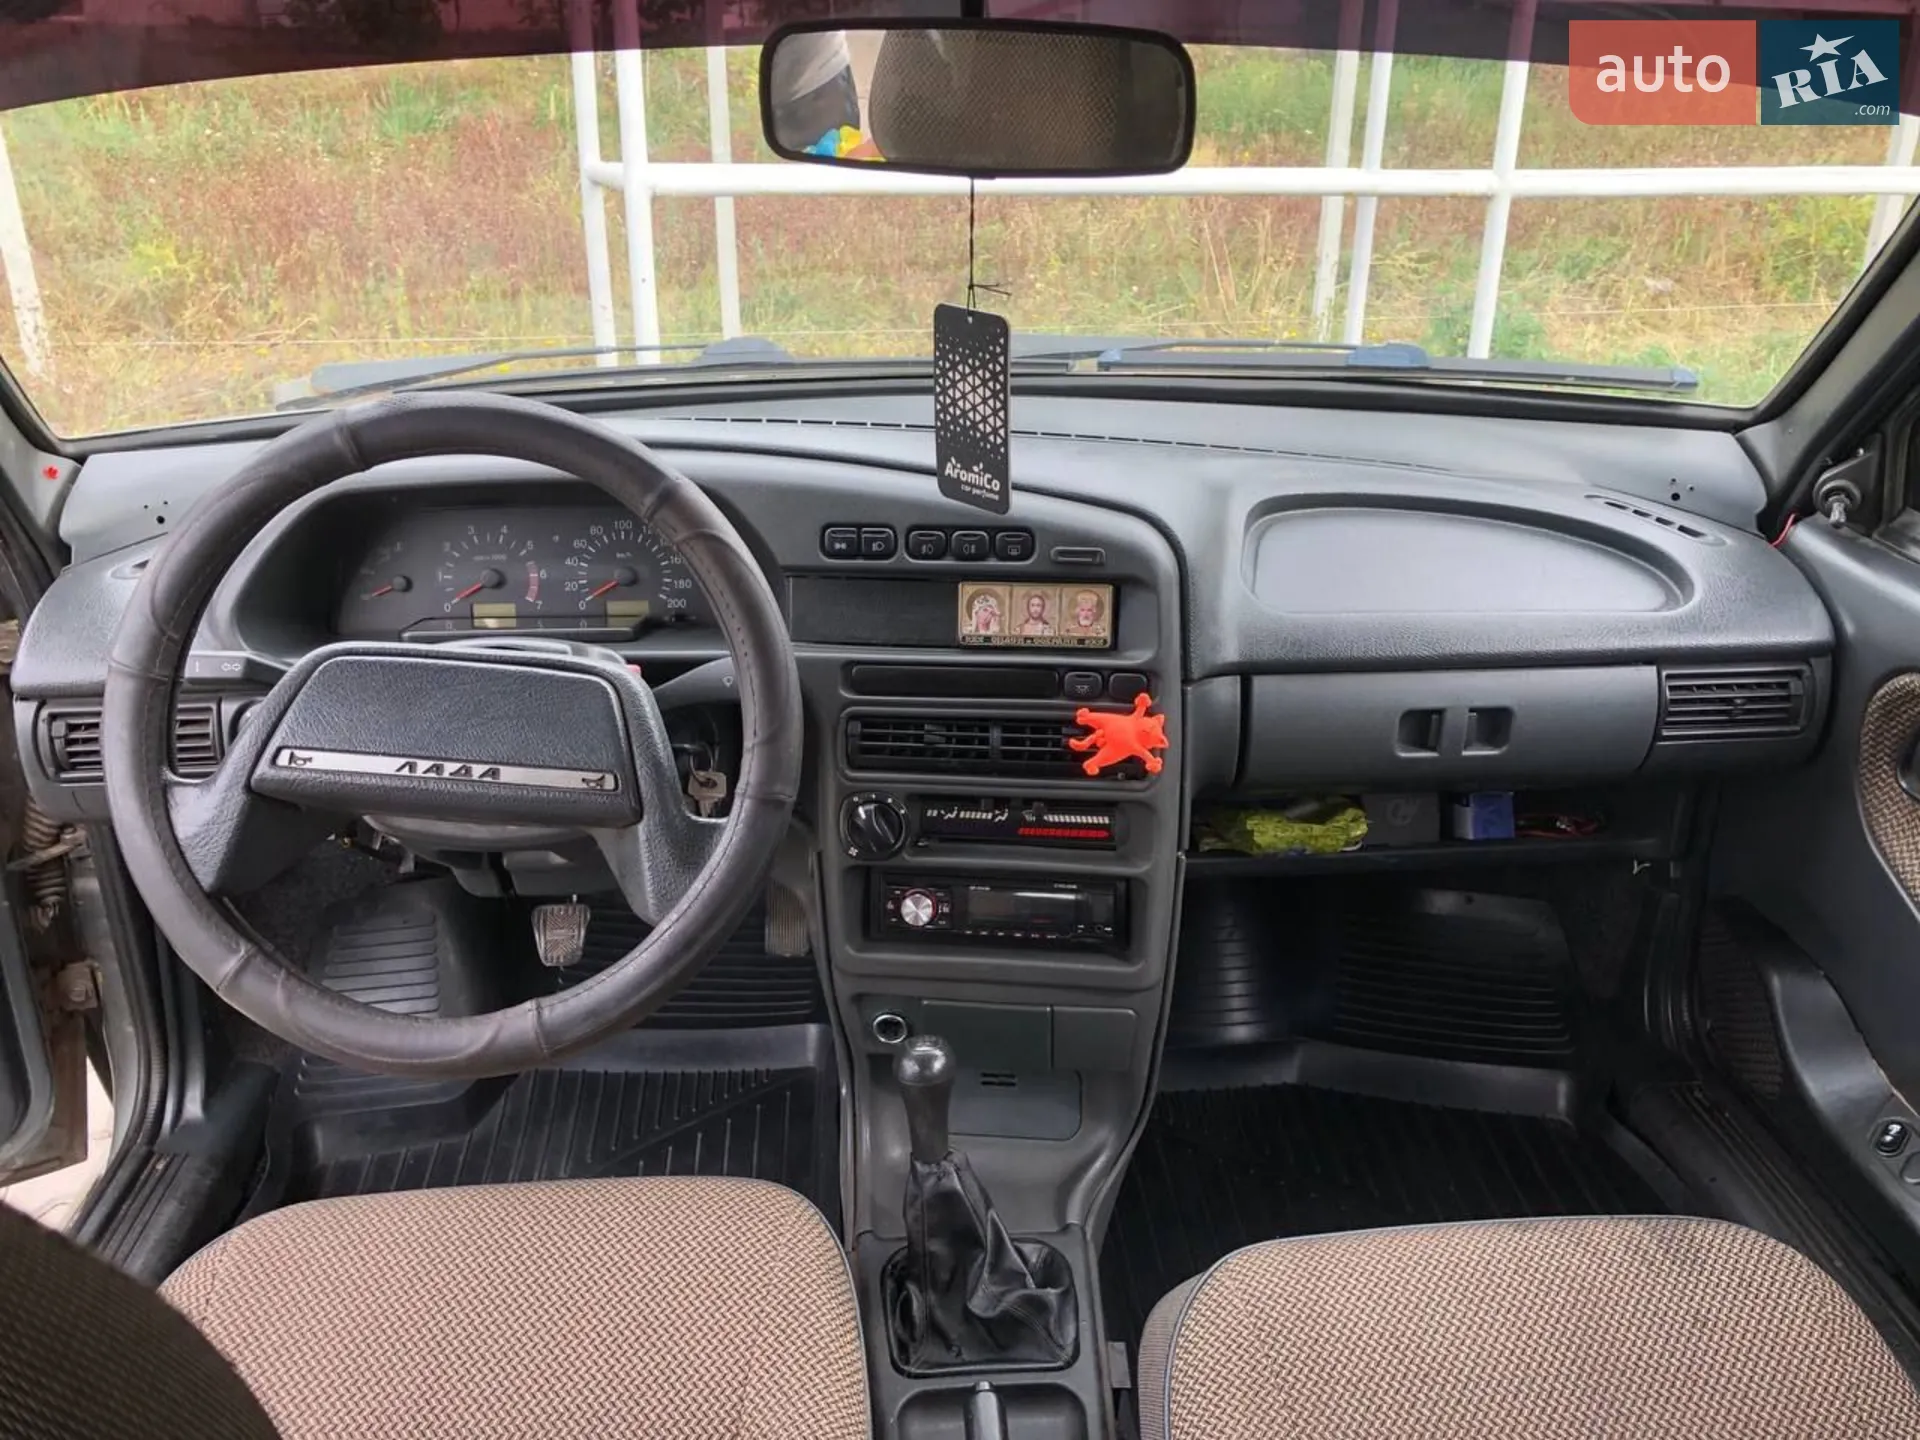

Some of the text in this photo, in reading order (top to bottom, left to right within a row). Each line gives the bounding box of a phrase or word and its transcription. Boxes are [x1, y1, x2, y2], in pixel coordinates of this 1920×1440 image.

[944, 460, 1001, 492] AromiCo
[467, 525, 476, 535] 3
[500, 524, 508, 534] 4
[589, 525, 604, 535] 80
[614, 520, 633, 530] 100
[526, 540, 534, 550] 5
[573, 539, 587, 549] 60
[564, 556, 579, 566] 40
[539, 569, 547, 579] 6
[563, 581, 578, 592] 20
[673, 580, 692, 589] 180
[443, 602, 452, 613] 0
[534, 600, 543, 610] 7
[578, 600, 586, 610] 0
[666, 598, 687, 609] 200
[395, 760, 500, 781] ЛАДА
